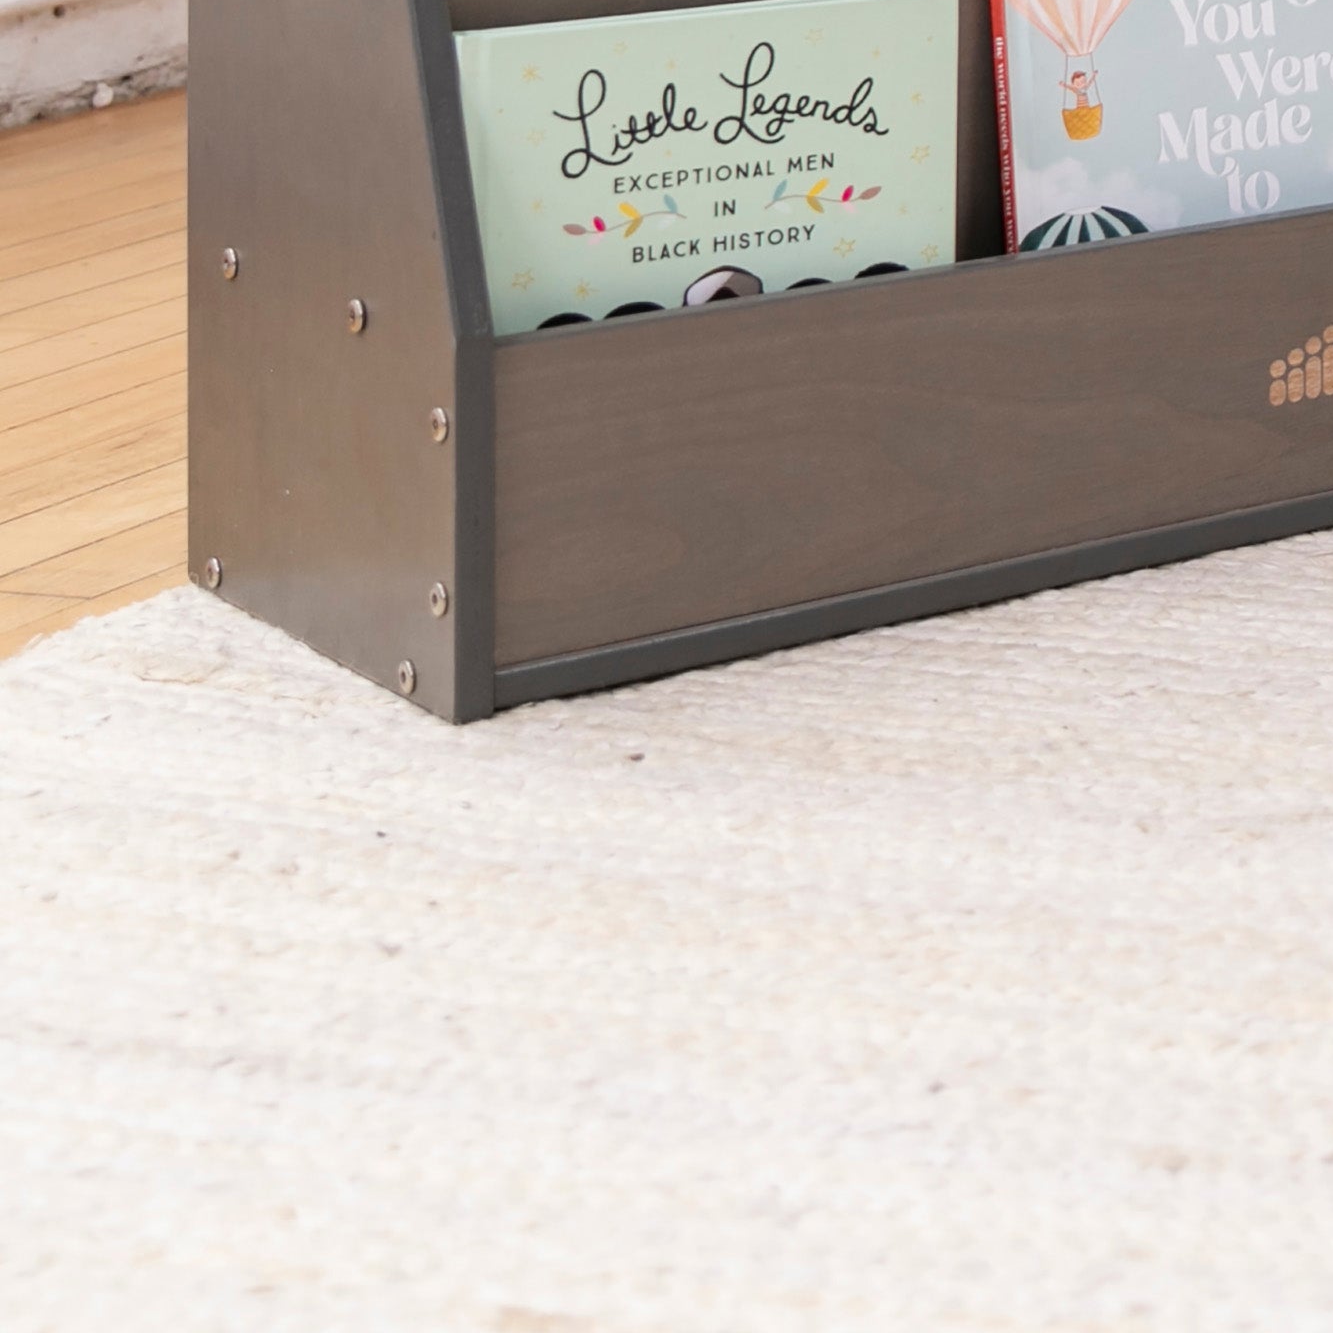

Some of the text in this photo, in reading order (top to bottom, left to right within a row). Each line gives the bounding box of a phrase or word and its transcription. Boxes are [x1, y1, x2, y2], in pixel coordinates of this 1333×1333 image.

[553, 42, 889, 178] Little Legends
[1157, 98, 1312, 176] Made
[613, 153, 836, 195] EXCEPTIONAL MEN
[1220, 156, 1281, 215] to
[713, 199, 737, 217] IN
[631, 225, 817, 263] BLACK HISTORY
